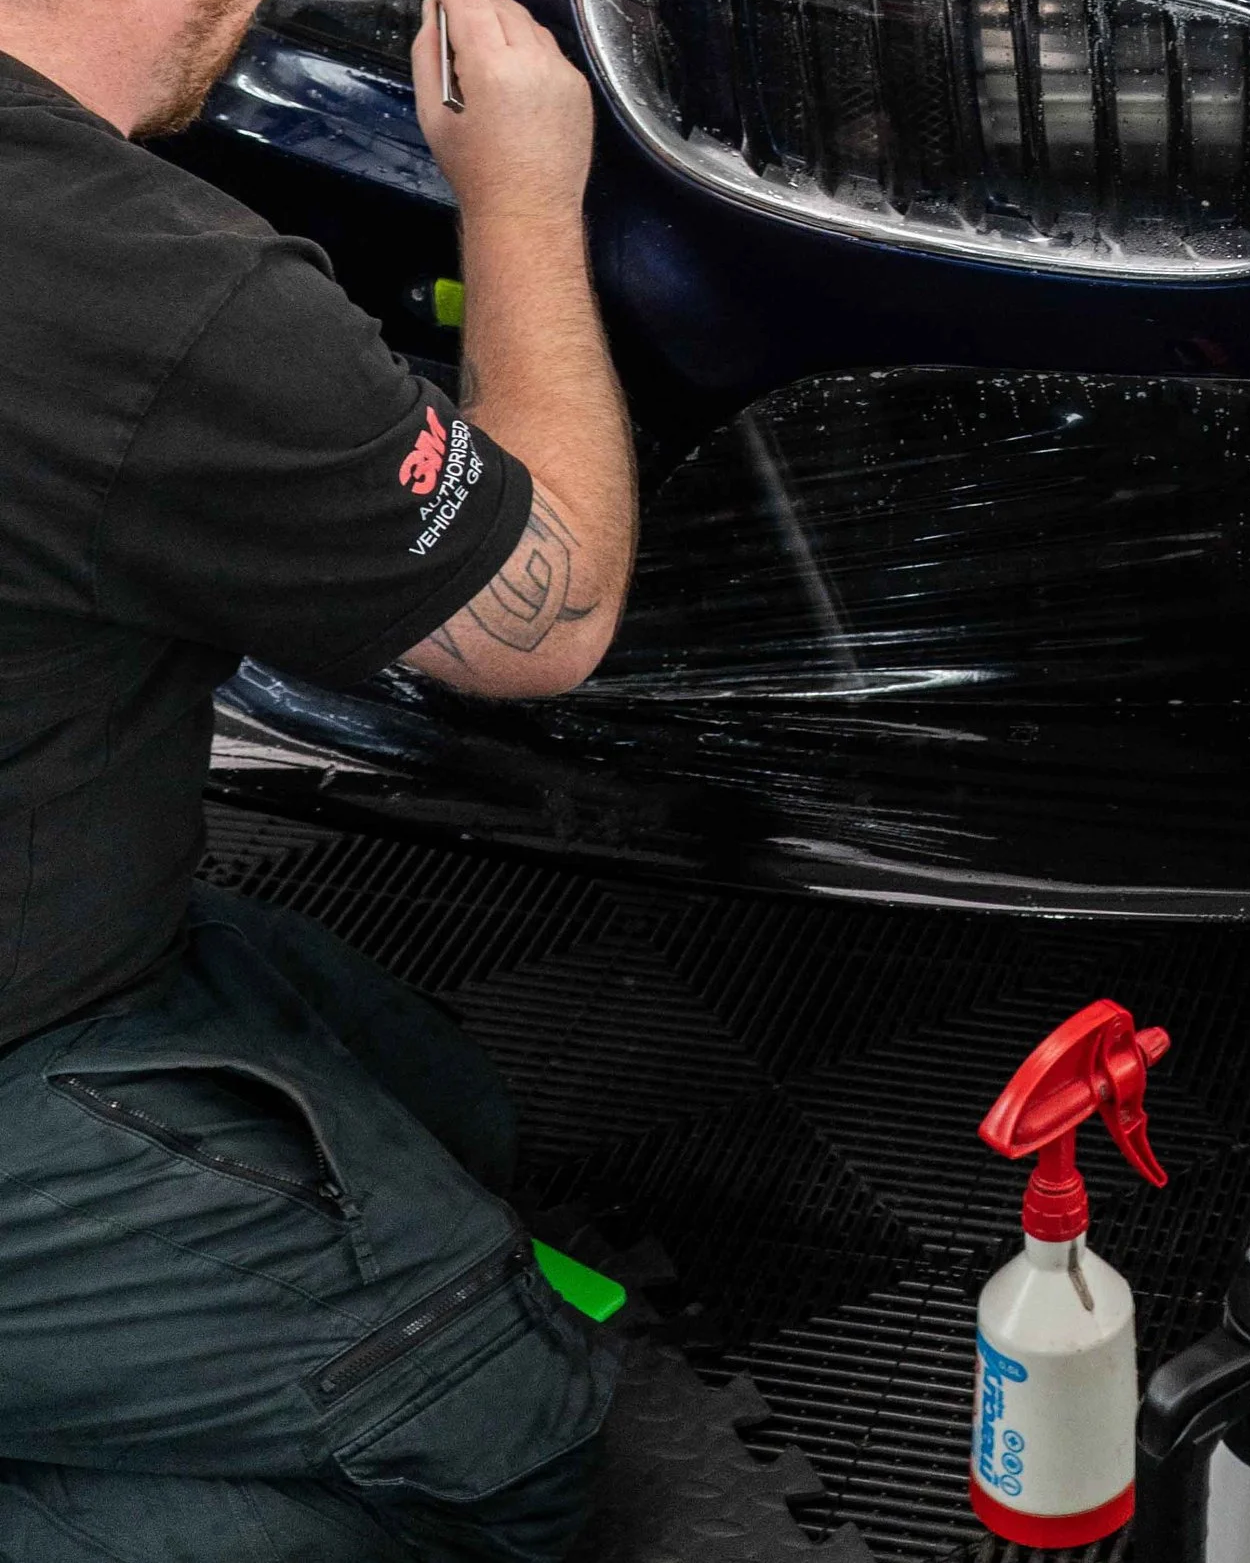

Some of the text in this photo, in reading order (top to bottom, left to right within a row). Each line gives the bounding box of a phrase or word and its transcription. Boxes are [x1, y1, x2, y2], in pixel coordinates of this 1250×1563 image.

[399, 405, 447, 495] 3M
[419, 419, 471, 521] AUTHORISED
[408, 484, 469, 556] VEHICLE
